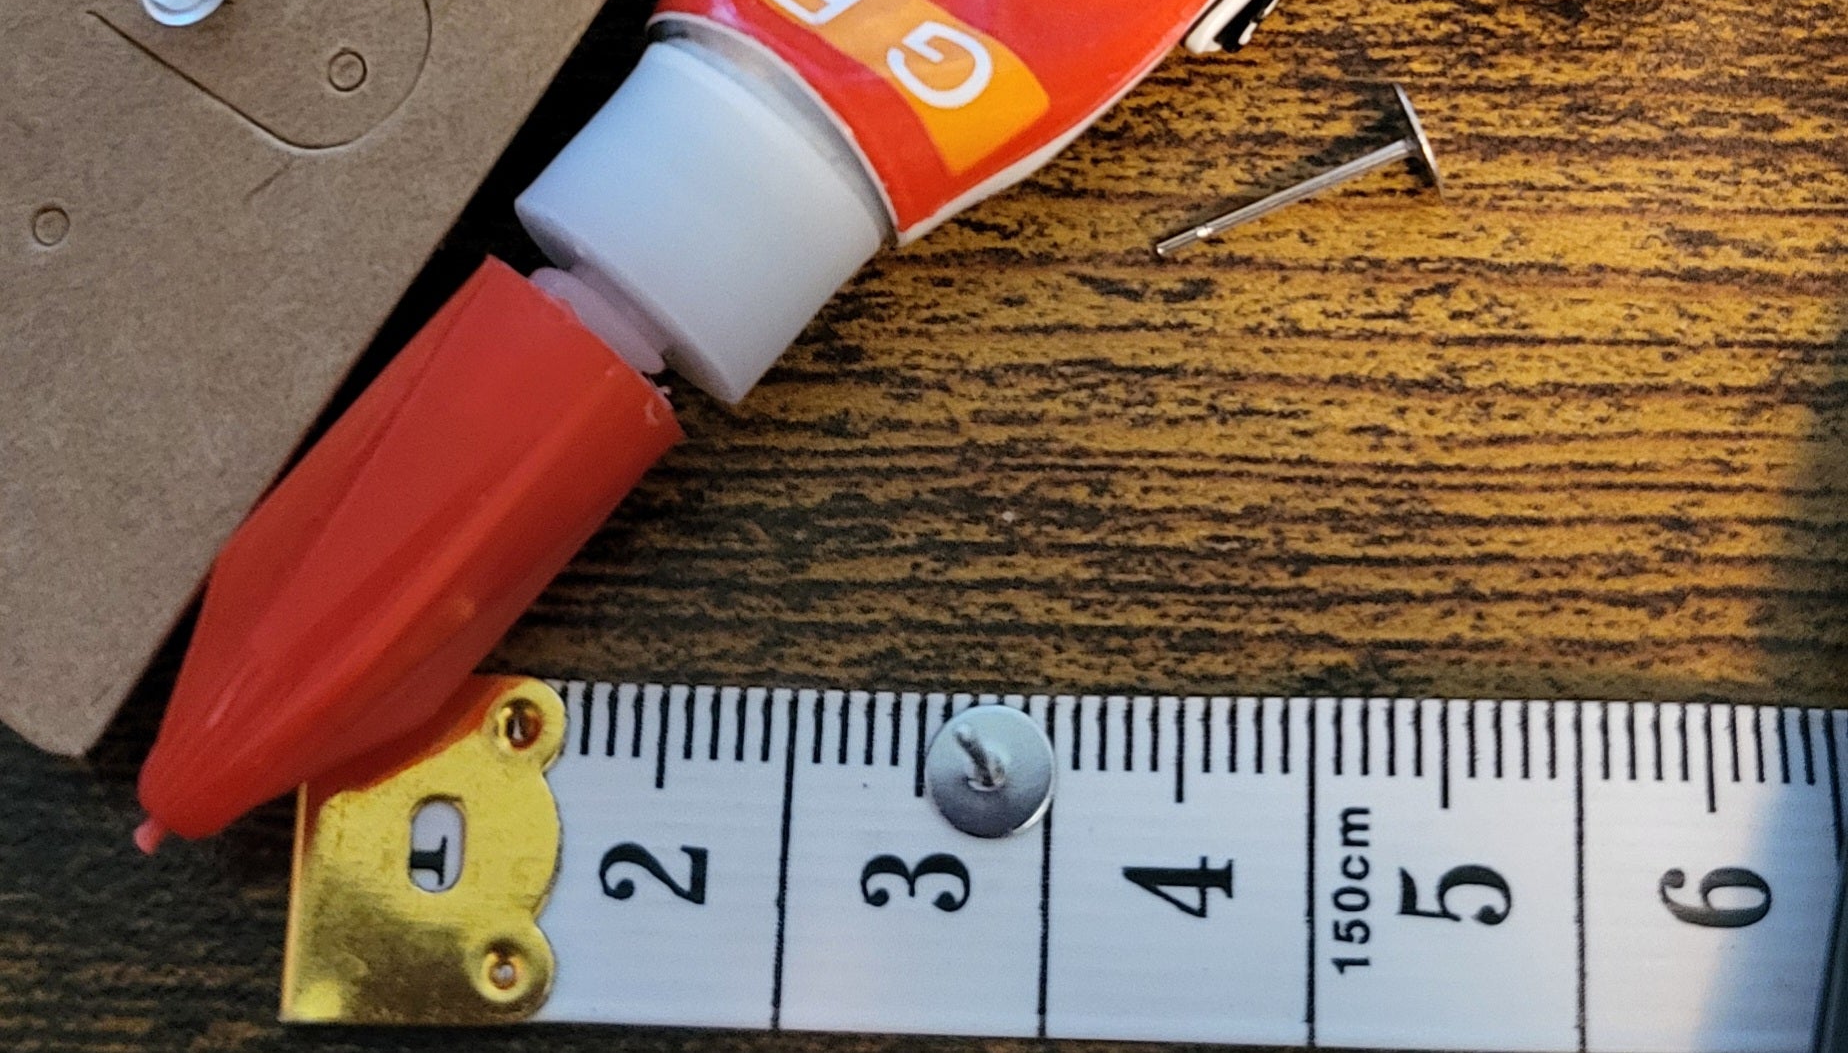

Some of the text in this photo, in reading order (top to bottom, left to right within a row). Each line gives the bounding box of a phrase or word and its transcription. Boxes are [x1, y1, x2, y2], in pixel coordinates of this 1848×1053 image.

[599, 842, 708, 905] 2
[860, 853, 971, 913] 3
[1122, 856, 1234, 918] 4
[1332, 807, 1371, 975] 150cm
[1397, 864, 1512, 926] 5
[1659, 867, 1773, 929] 6
